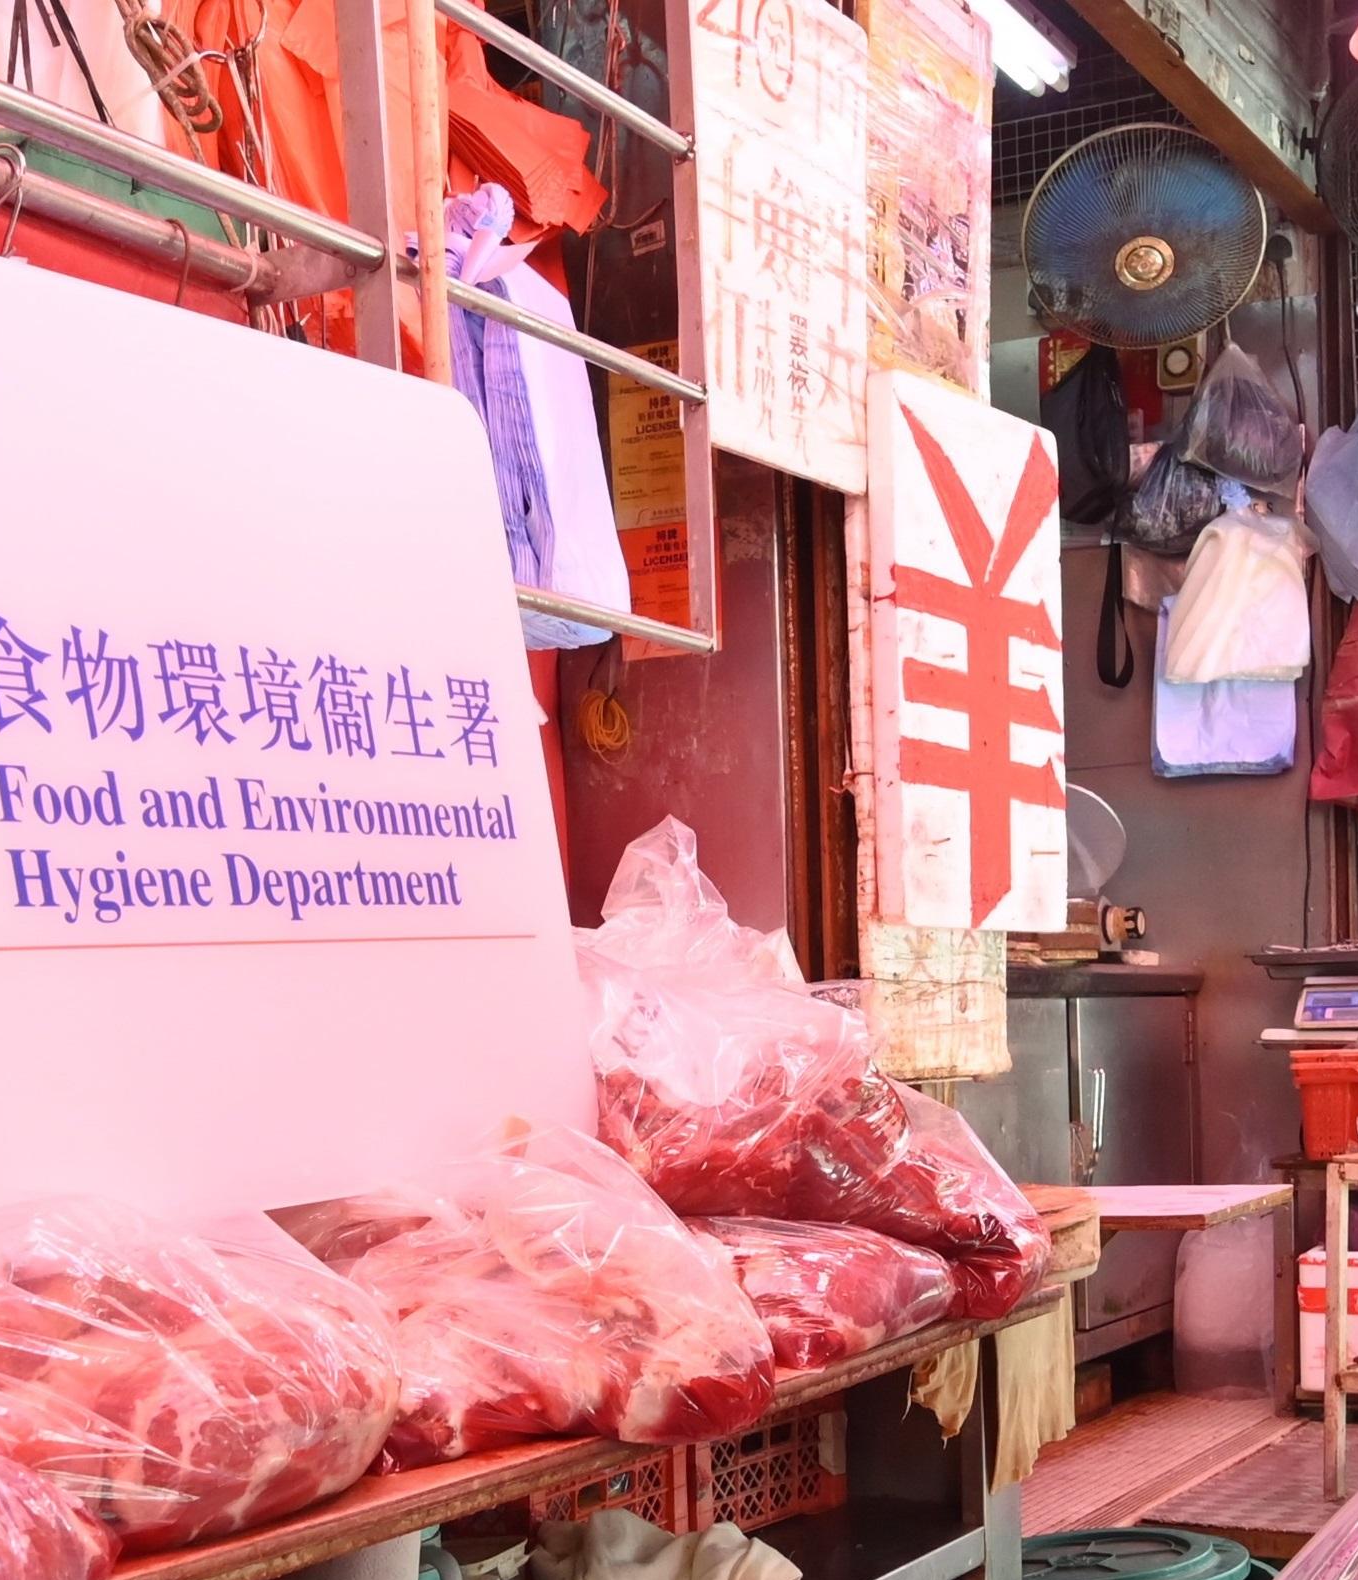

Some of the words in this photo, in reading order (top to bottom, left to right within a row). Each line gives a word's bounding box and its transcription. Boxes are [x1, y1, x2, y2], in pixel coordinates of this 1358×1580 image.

[140, 775, 227, 830] and
[234, 776, 517, 841] Environmental
[4, 847, 214, 924] Hygiene
[222, 851, 464, 921] Department
